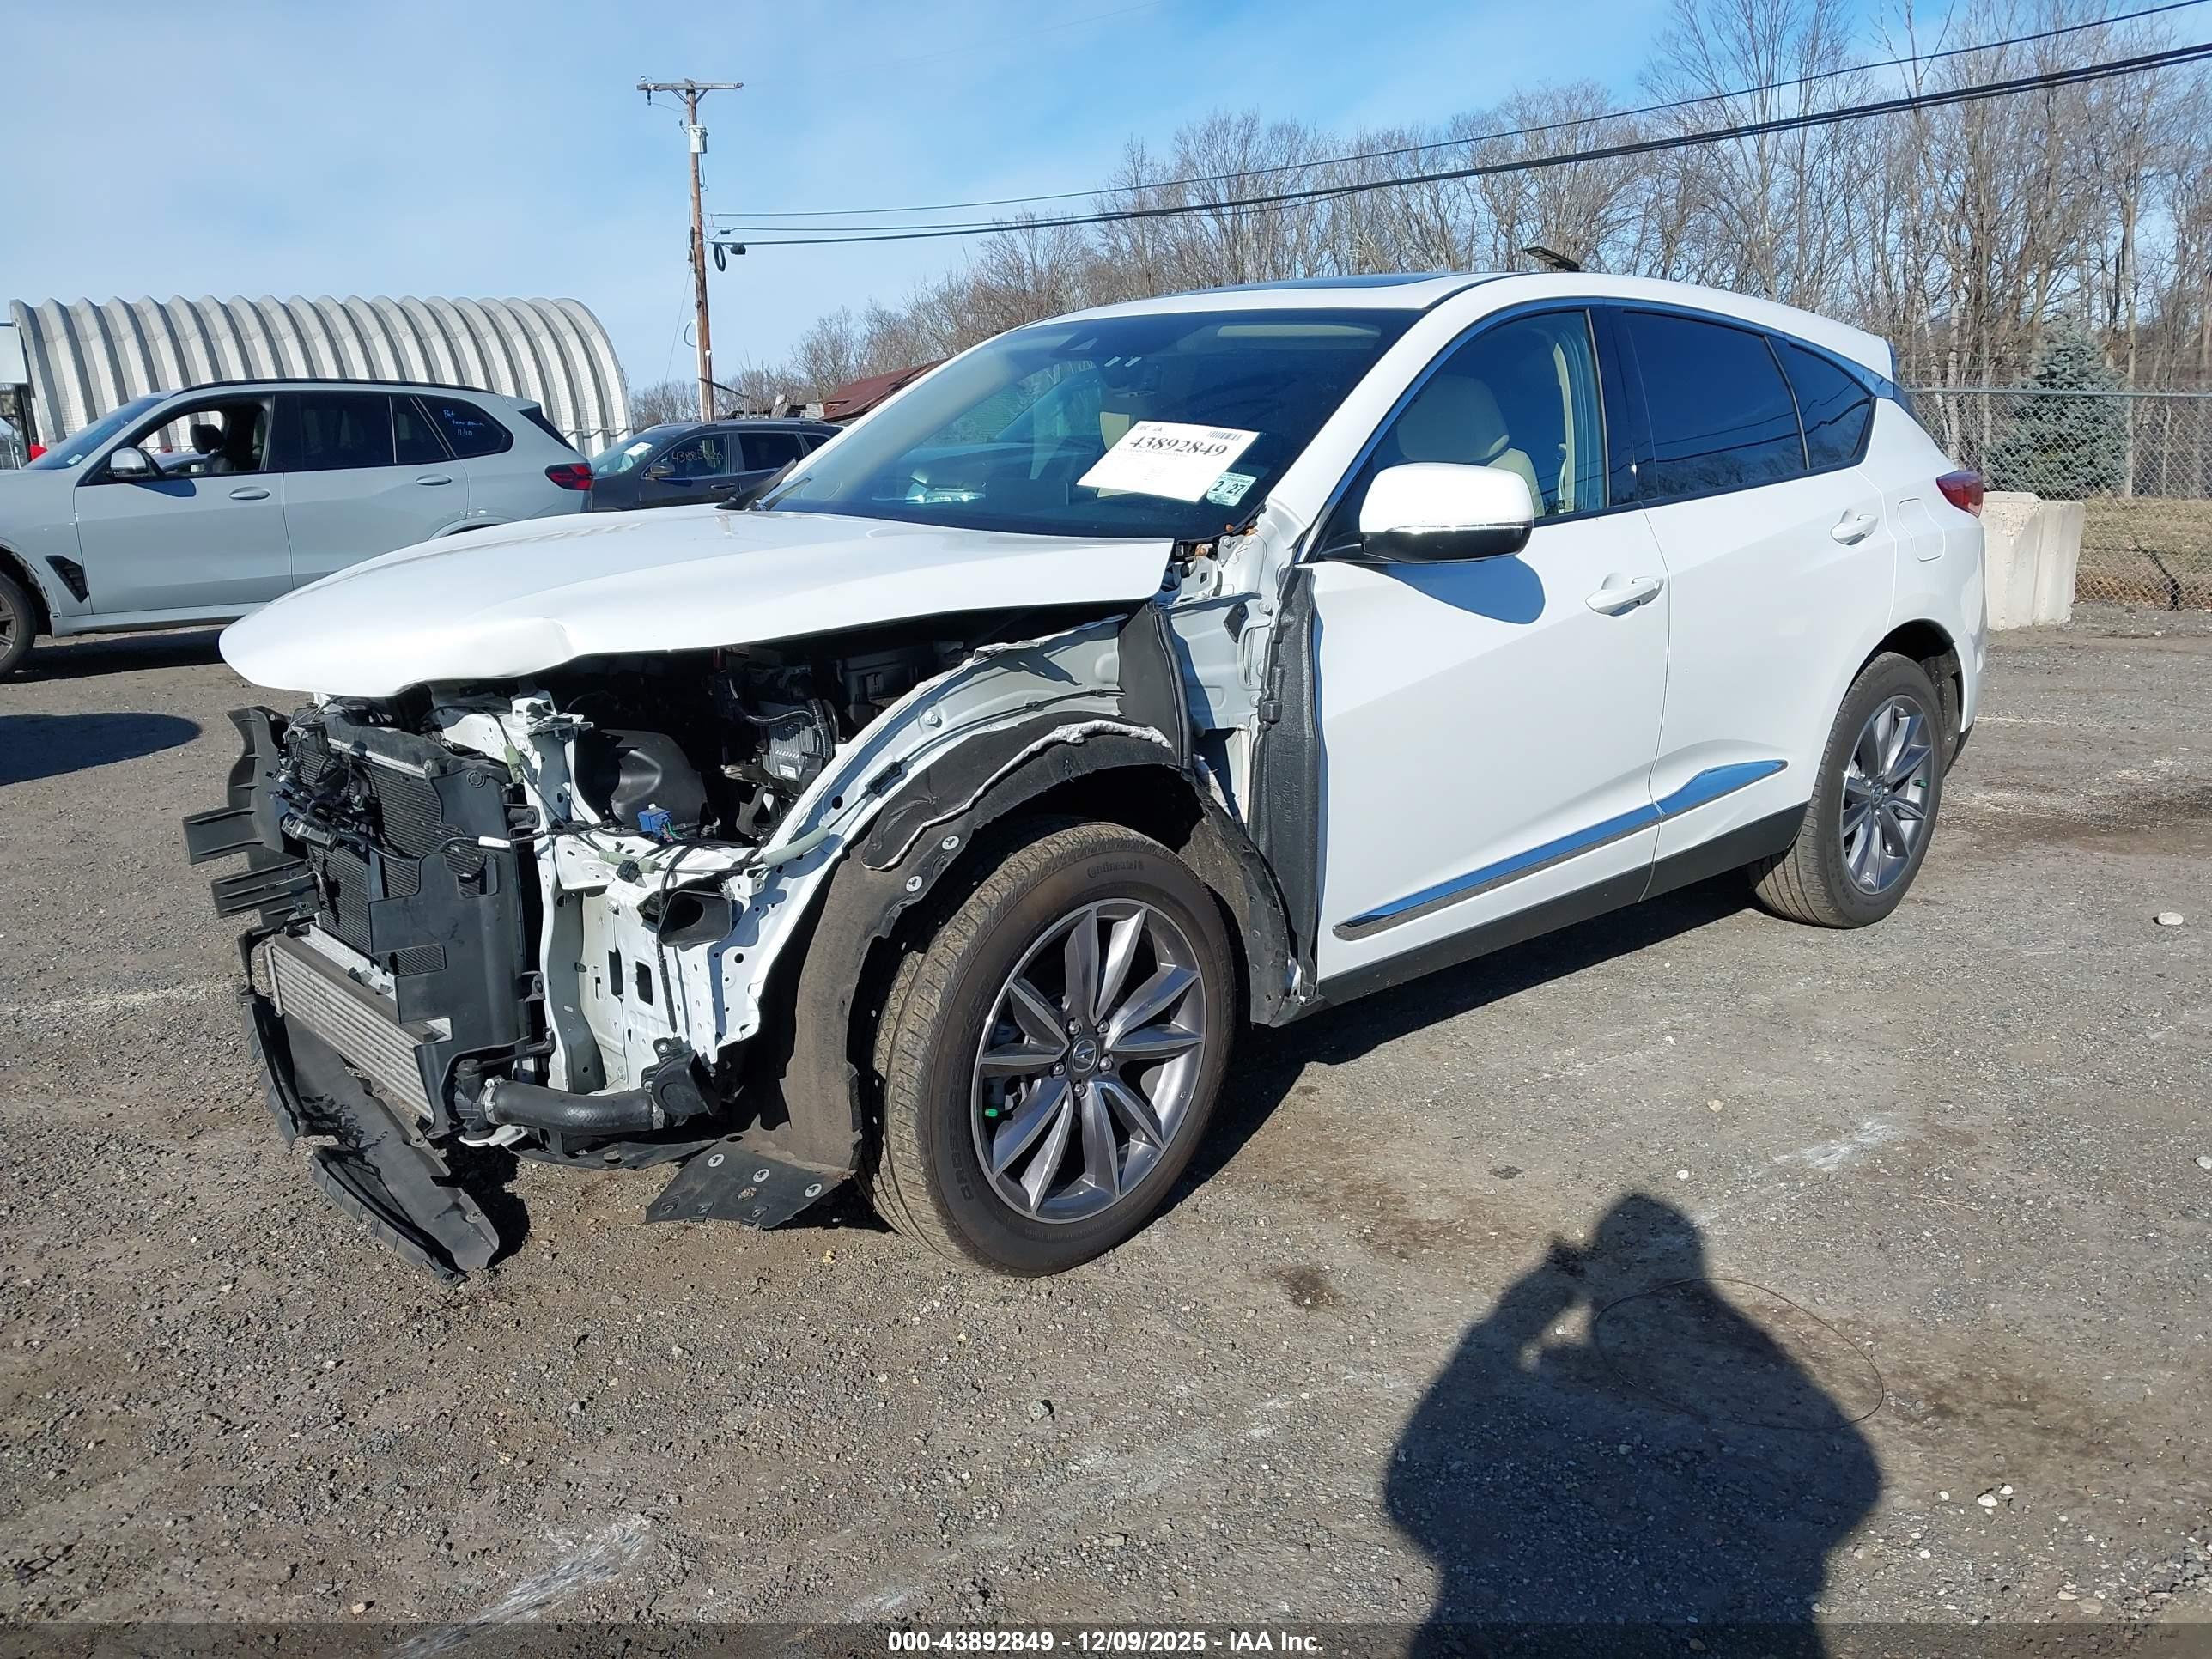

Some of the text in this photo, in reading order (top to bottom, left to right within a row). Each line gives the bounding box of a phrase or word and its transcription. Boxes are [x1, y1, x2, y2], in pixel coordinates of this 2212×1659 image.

[1129, 436, 1228, 456] 43892849
[1212, 481, 1224, 492] 2
[1226, 483, 1247, 495] 27
[1086, 860, 1138, 879] Continental
